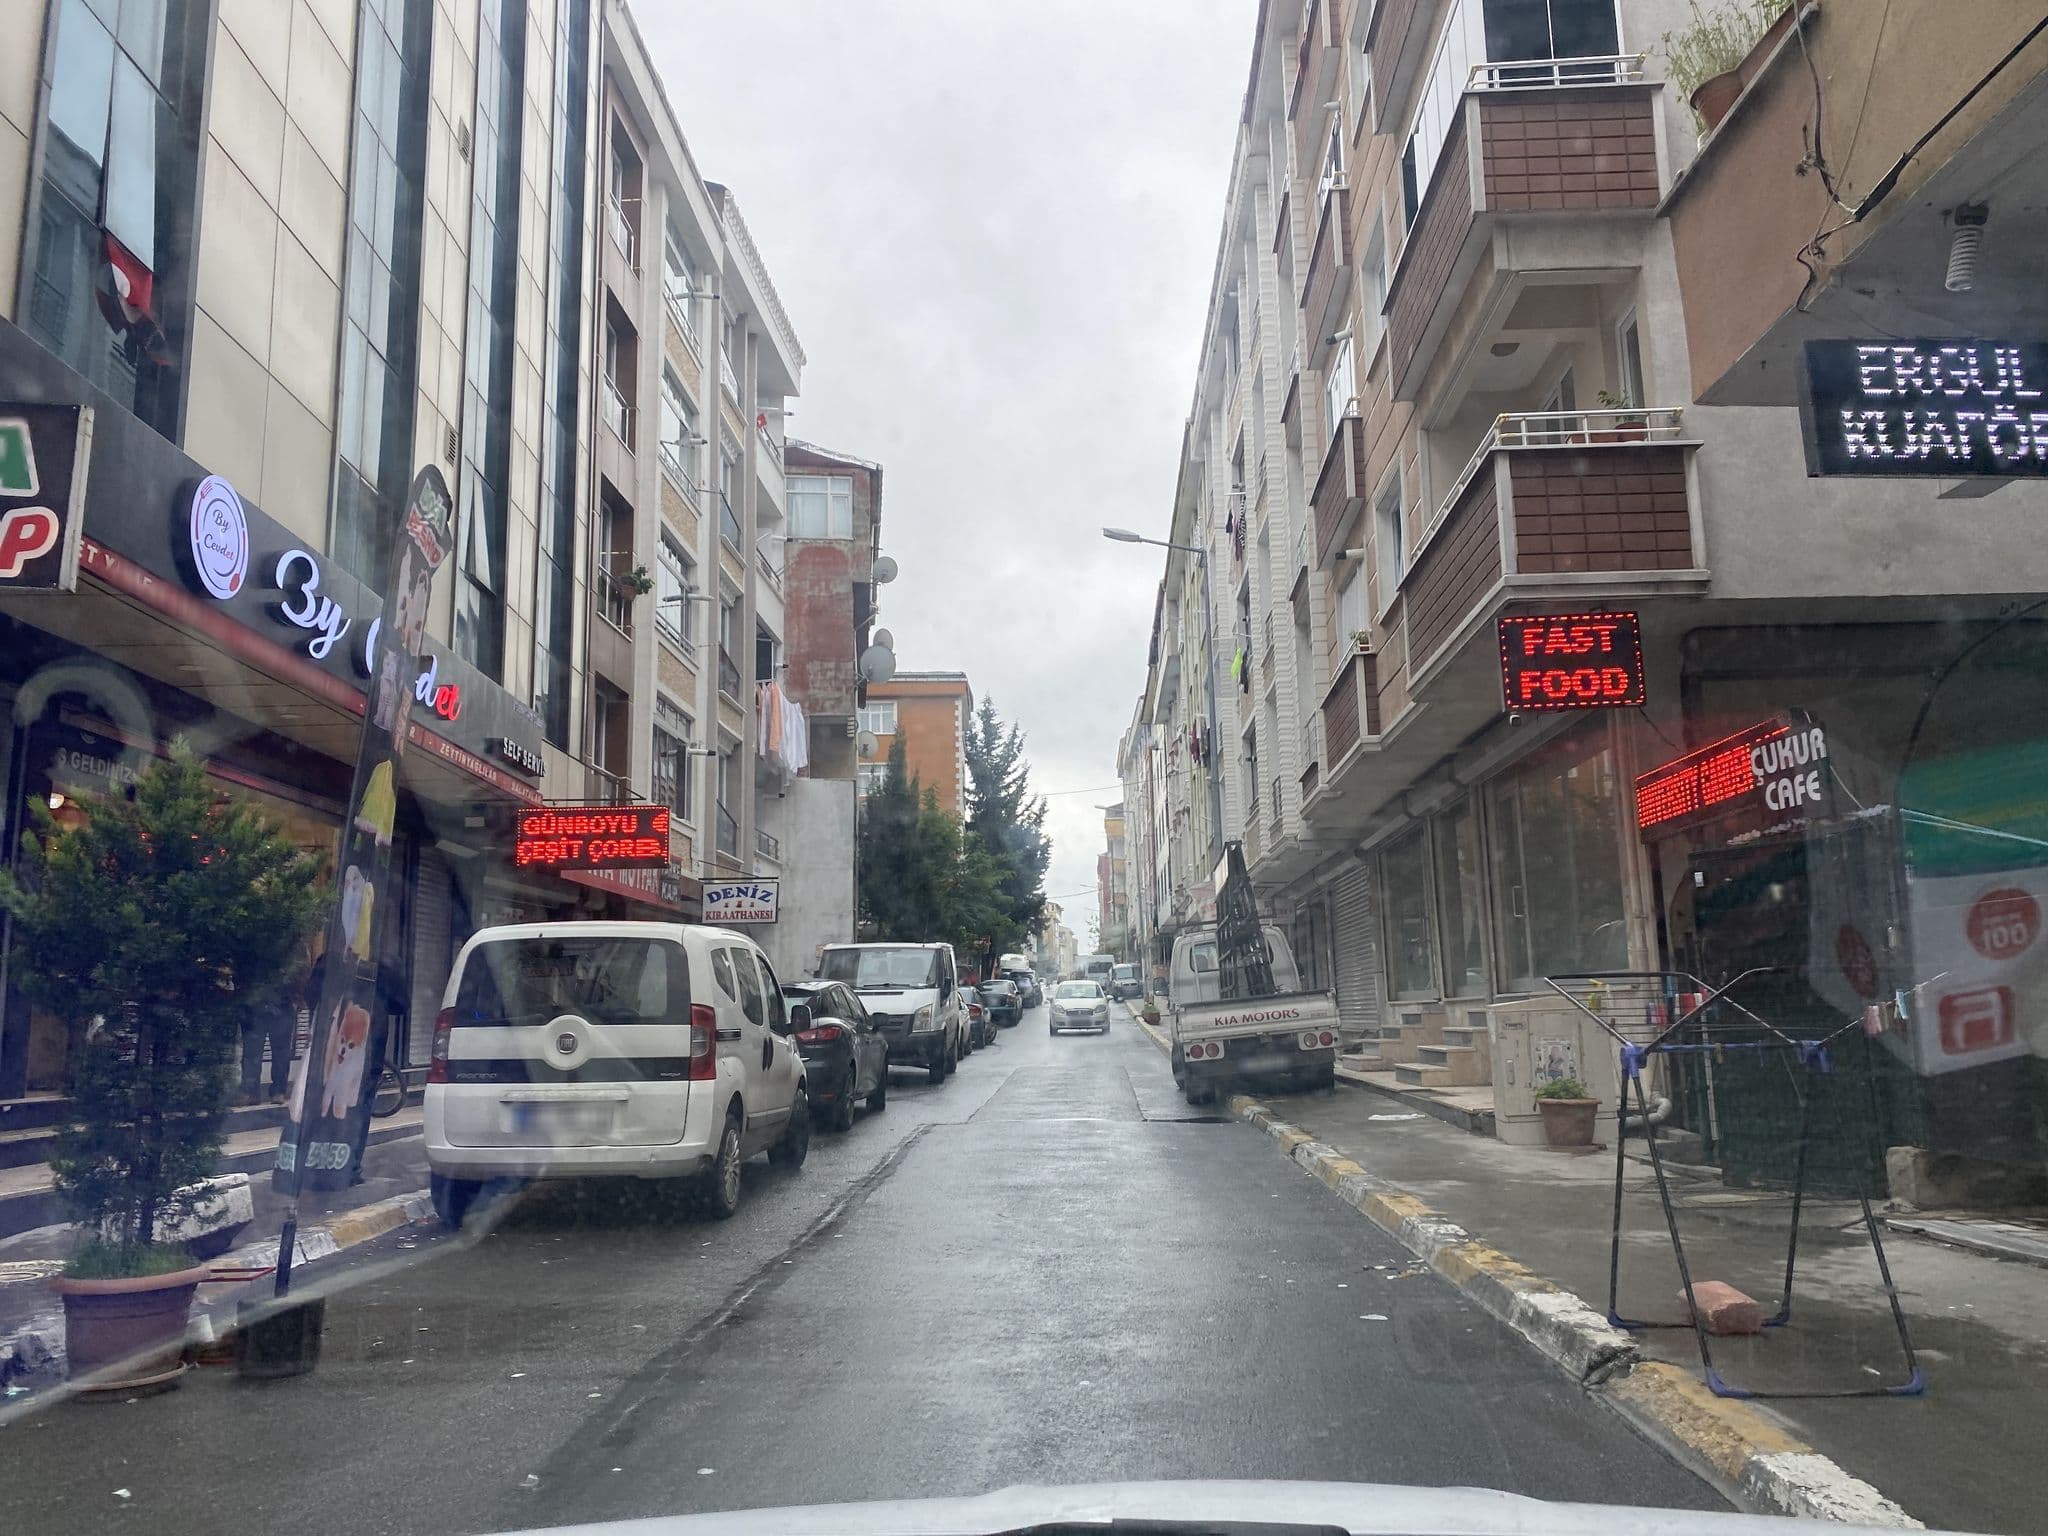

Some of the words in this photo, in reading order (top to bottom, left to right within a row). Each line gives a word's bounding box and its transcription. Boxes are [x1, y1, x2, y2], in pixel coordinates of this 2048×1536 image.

[213, 509, 230, 533] By
[1522, 625, 1618, 656] FAST
[1519, 667, 1628, 699] FOOD
[503, 737, 522, 762] SELF
[1750, 727, 1827, 786] ÇUKUR
[1765, 770, 1822, 811] CAFE
[523, 812, 638, 835] GÜNBOYU
[518, 837, 583, 864] ÇEŞİT
[588, 839, 668, 863] ÇORB
[706, 884, 774, 904] DENİZ
[1214, 1016, 1238, 1027] KIA
[1242, 1008, 1300, 1024] MOTORS
